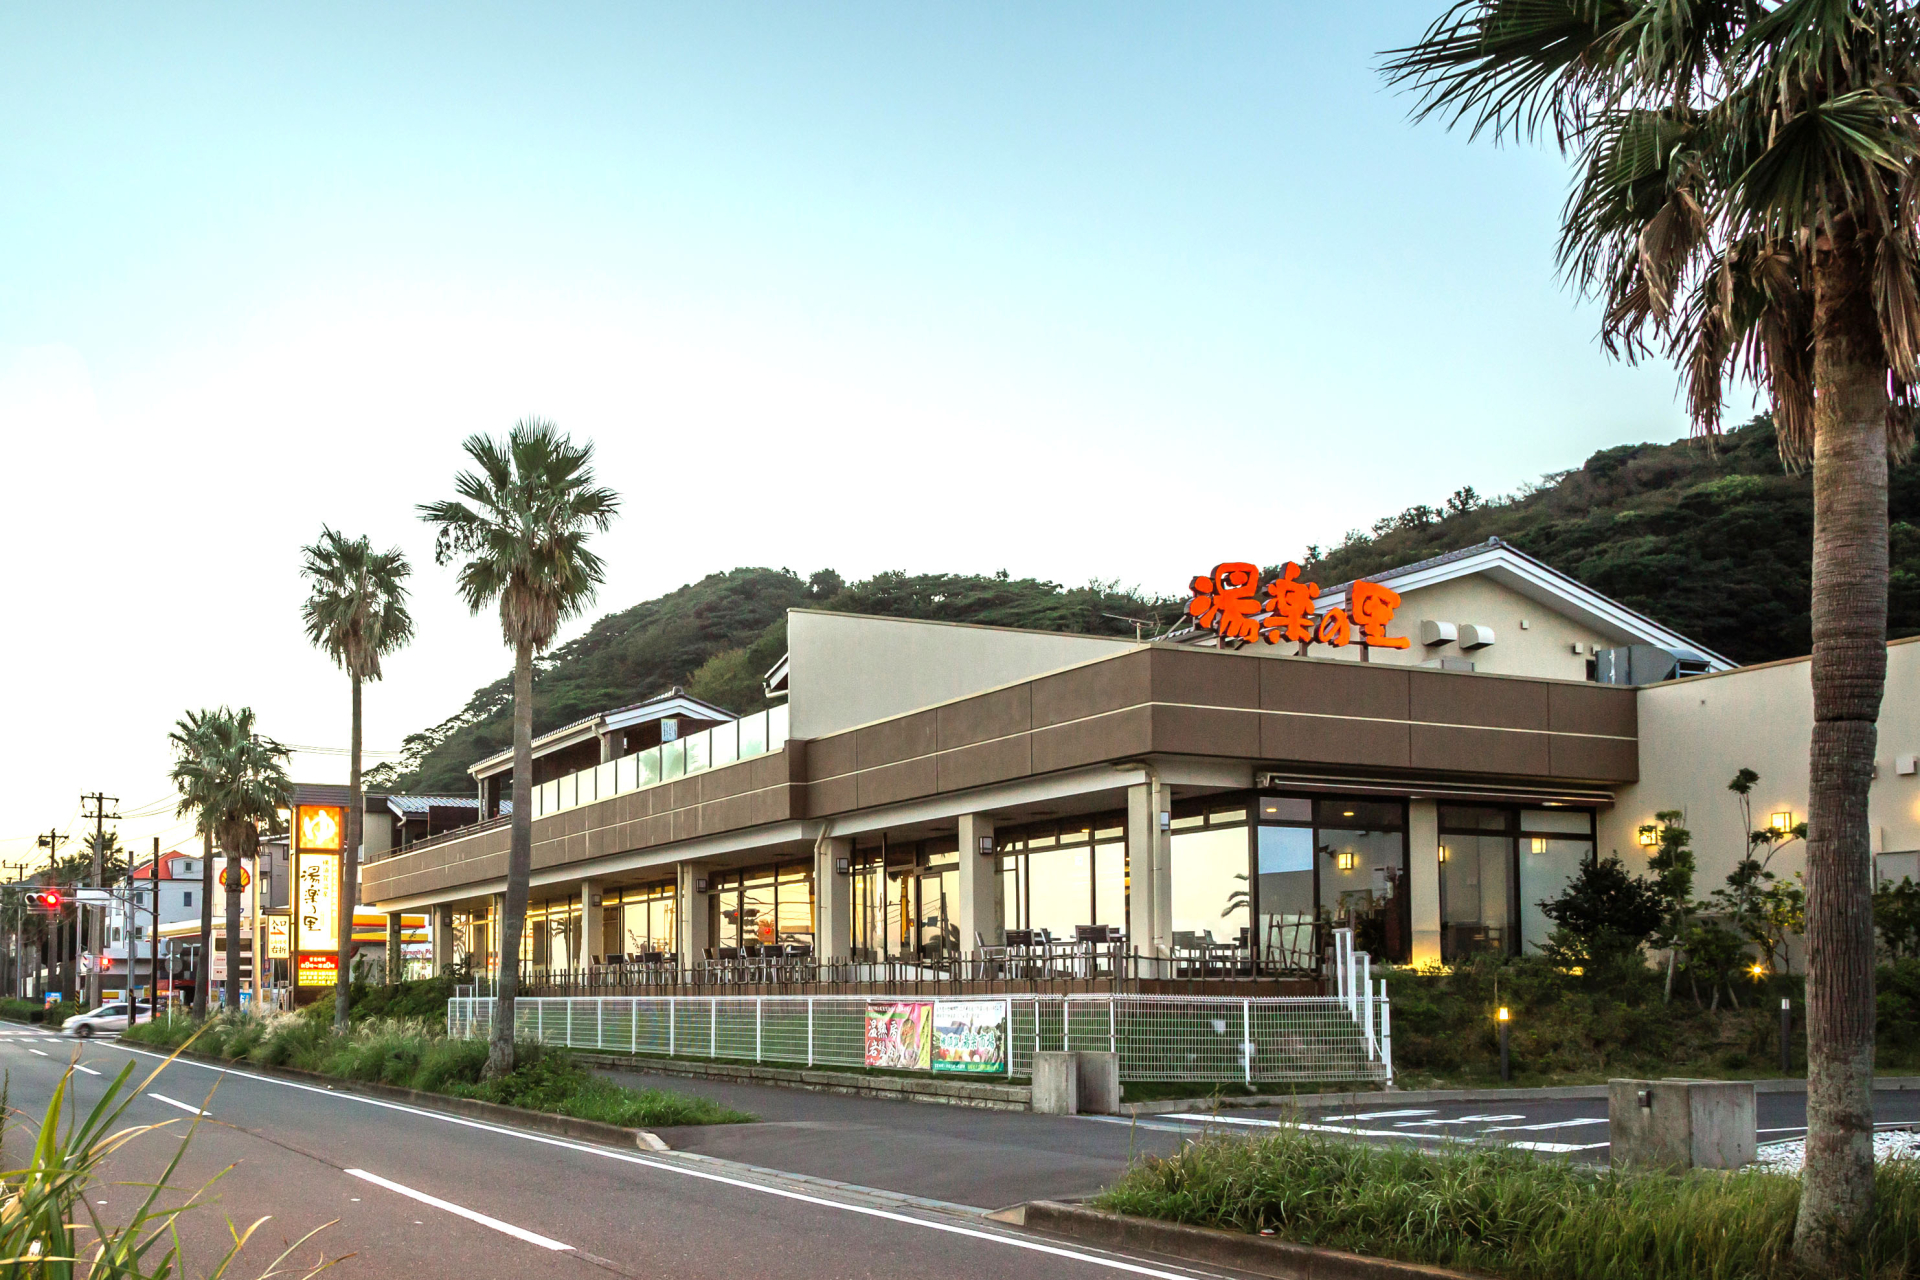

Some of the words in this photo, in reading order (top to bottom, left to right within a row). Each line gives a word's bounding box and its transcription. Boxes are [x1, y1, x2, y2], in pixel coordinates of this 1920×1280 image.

[1189, 561, 1411, 649] 湯楽の里
[304, 810, 336, 845] ゆ
[271, 919, 287, 927] 入口
[270, 945, 287, 955] 右折
